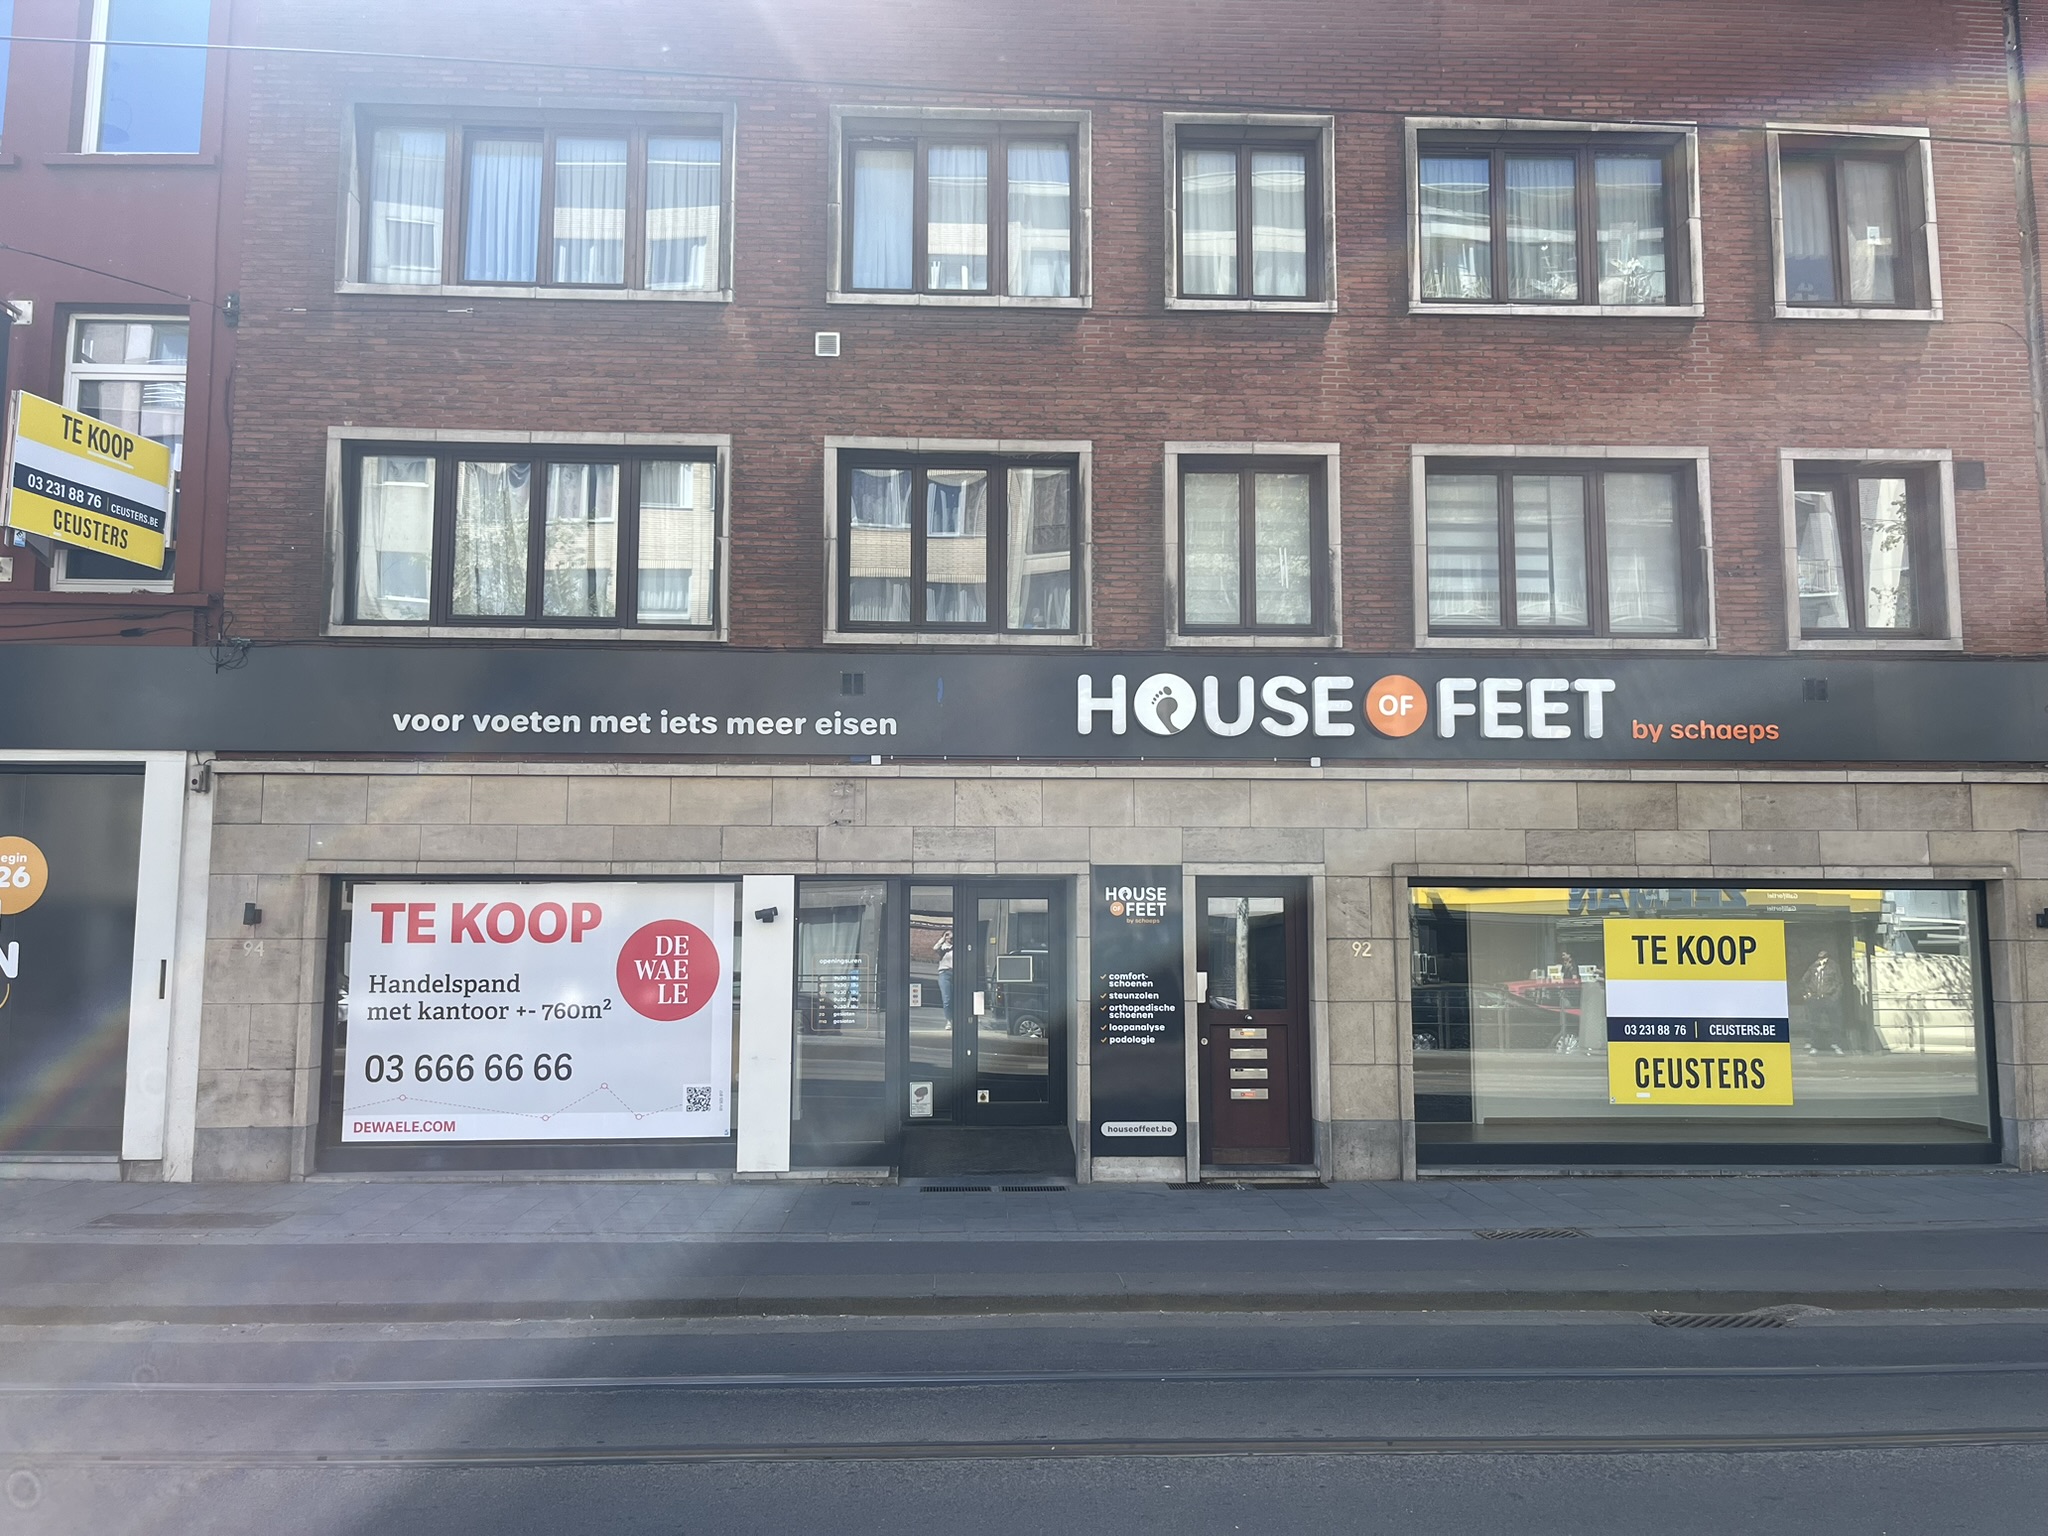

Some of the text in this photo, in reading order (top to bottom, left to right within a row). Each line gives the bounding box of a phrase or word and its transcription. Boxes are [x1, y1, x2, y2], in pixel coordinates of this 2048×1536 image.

[61, 413, 134, 461] TE KOOP
[27, 473, 159, 528] 03 231 88 76 CEUSTERS.BE
[53, 509, 129, 550] CEUSTERS
[1077, 673, 1780, 743] HOUSE OF FEET by schaeps
[393, 709, 898, 736] voor voeten met iets meer eisen
[1105, 886, 1167, 901] HOUSE
[1125, 902, 1167, 917] FEET
[371, 902, 602, 943] TE KOOP
[243, 940, 264, 957] 94
[655, 935, 689, 957] DE
[1352, 942, 1372, 957] 92
[1631, 935, 1757, 965] TE KOOP
[634, 960, 689, 981] WAE
[1109, 972, 1149, 980] comfort-
[369, 974, 520, 1000] Handelspand
[657, 983, 688, 1004] LE
[367, 1003, 411, 1020] met
[418, 1002, 509, 1020] kantoor
[1109, 1004, 1175, 1013] orthopedische
[1109, 1023, 1165, 1032] loopanalyse
[1624, 1024, 1776, 1036] 03 231 88 76 CEUSTERS.BE
[1109, 1035, 1155, 1045] podologie
[365, 1053, 573, 1082] 03 666 66 66
[1635, 1057, 1765, 1089] CEUSTERS
[353, 1121, 456, 1134] DEWAELE.COM
[1107, 1125, 1172, 1134] houseoffeet.be
